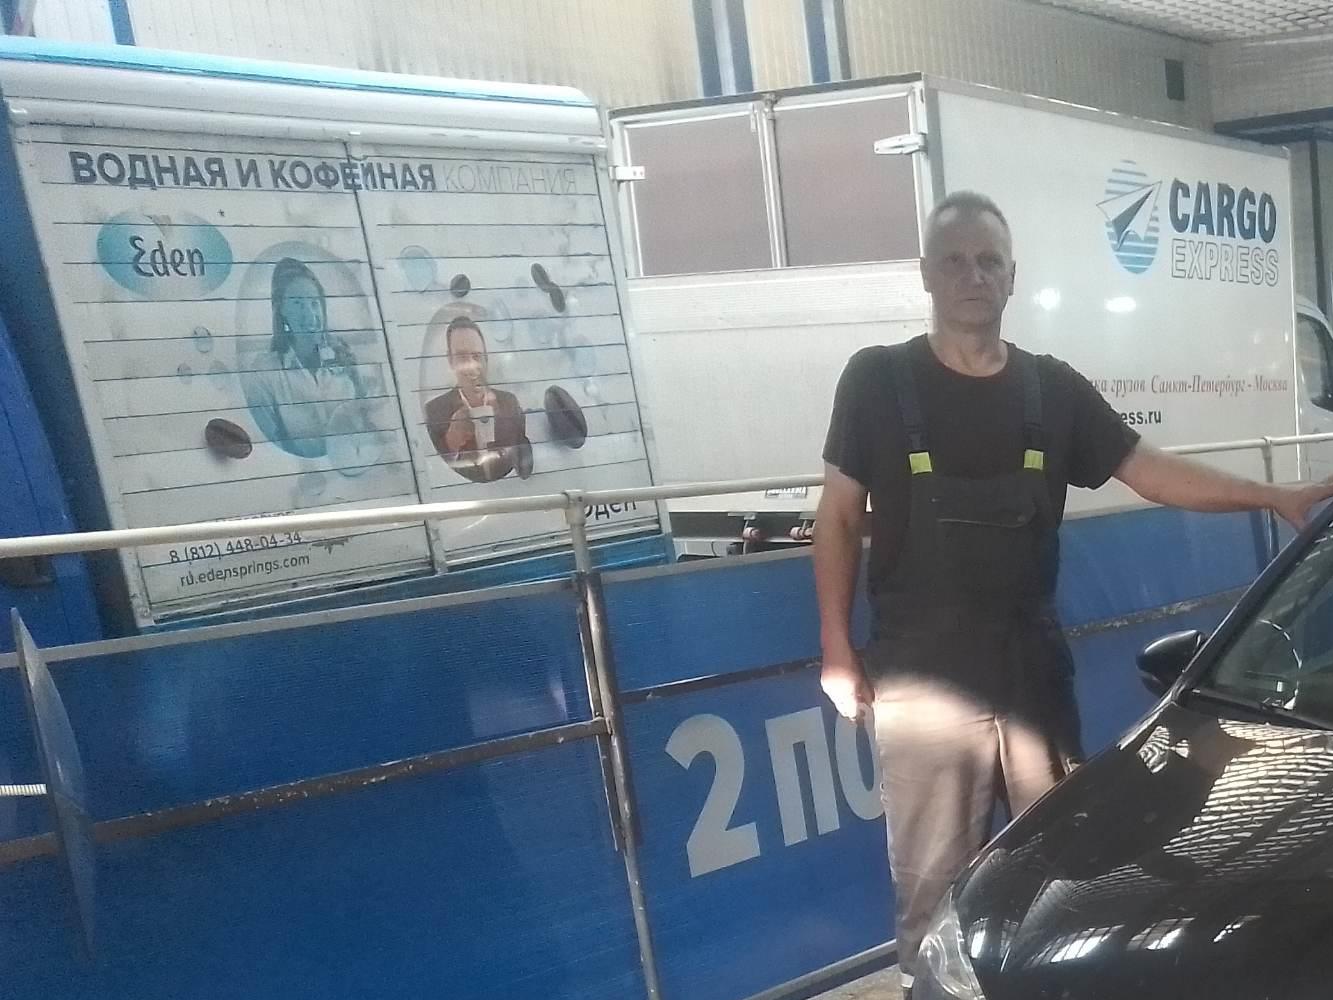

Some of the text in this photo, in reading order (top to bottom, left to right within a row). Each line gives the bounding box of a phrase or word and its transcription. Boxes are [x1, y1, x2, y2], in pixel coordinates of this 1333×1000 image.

[69, 151, 228, 190] ВОДНАЯ
[235, 158, 262, 188] И
[443, 163, 578, 193] КОМПАНИЯ
[1168, 177, 1277, 244] CARGO
[129, 235, 206, 277] Eden
[1170, 238, 1279, 287] EXPRESS
[169, 531, 302, 565] 8 (812) 448-04-34
[180, 553, 310, 588] ru.edensprings.com
[665, 713, 760, 878] 2
